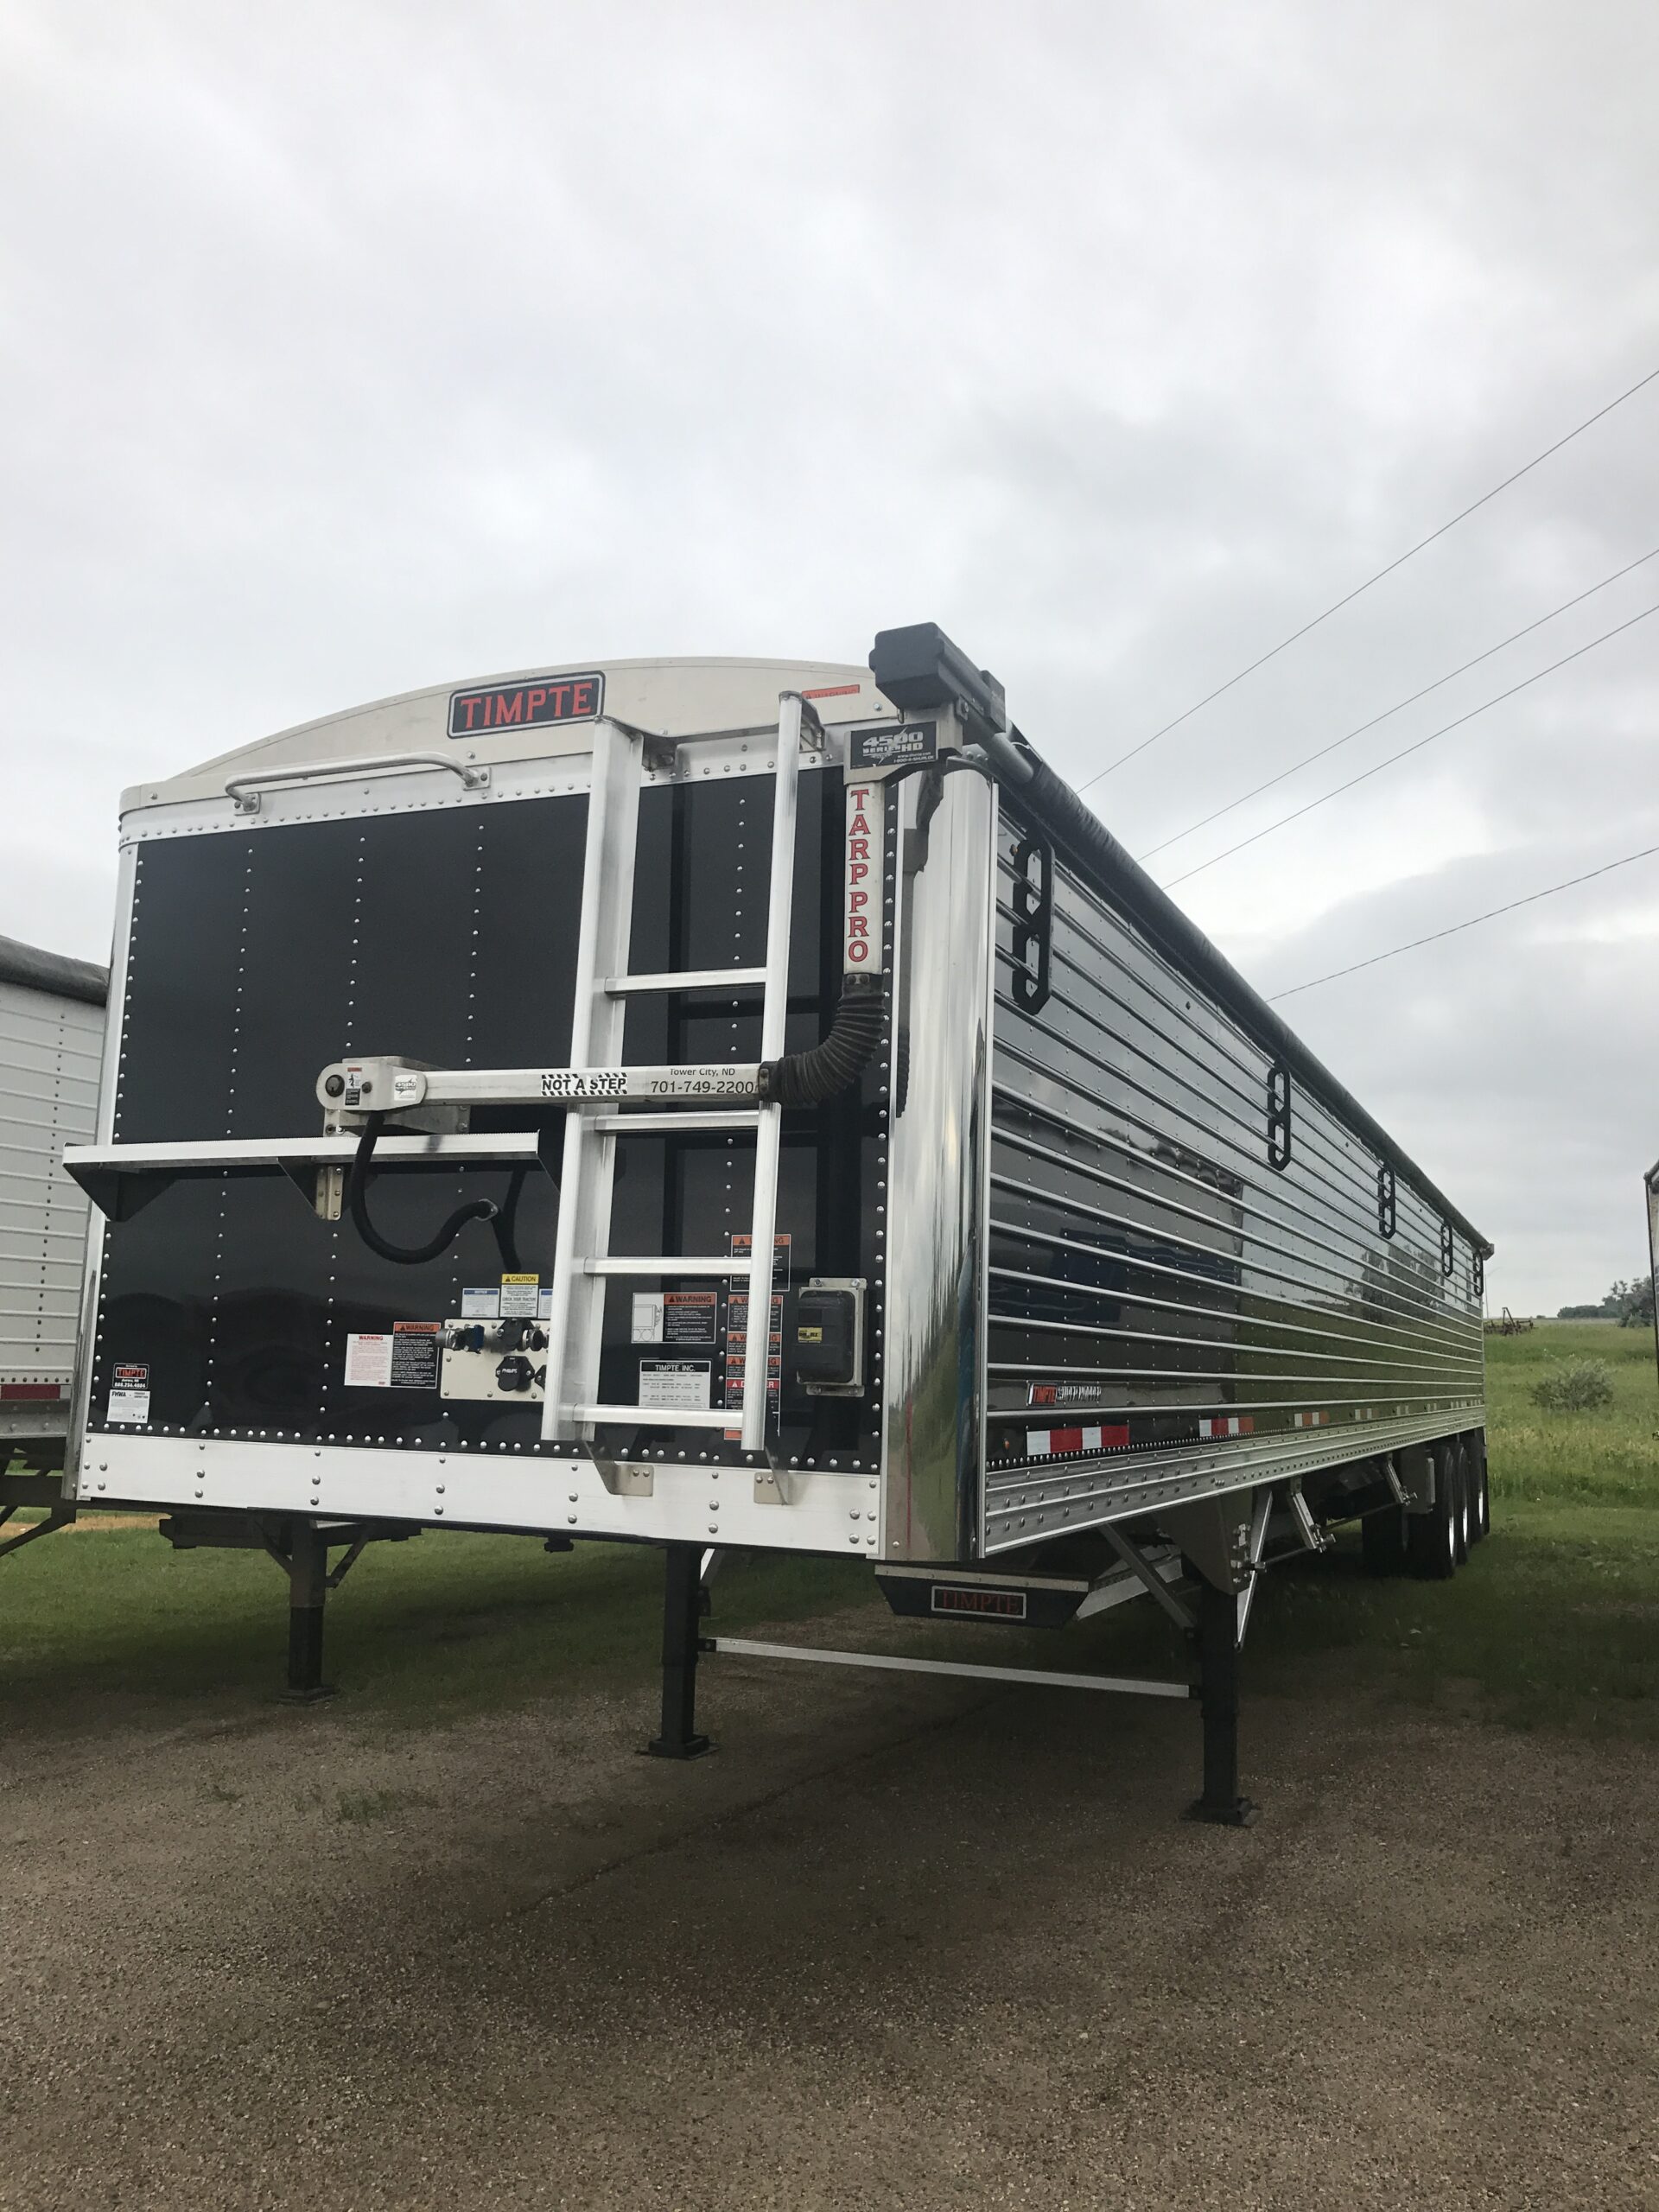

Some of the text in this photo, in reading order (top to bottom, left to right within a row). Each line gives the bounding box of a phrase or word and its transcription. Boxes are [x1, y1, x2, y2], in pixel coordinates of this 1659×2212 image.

[461, 683, 592, 728] TIMPTE
[863, 732, 924, 747] 4500
[900, 742, 924, 752] HD
[849, 789, 871, 886] TARP
[848, 892, 870, 963] PRO
[699, 1068, 719, 1077] City,
[542, 1078, 626, 1090] NOT A STEP
[651, 1081, 754, 1094] 701-749-2200
[118, 1369, 144, 1377] TIMPTE
[1033, 1386, 1056, 1403] TIMPTE
[943, 1590, 1020, 1615] TIMPTE
